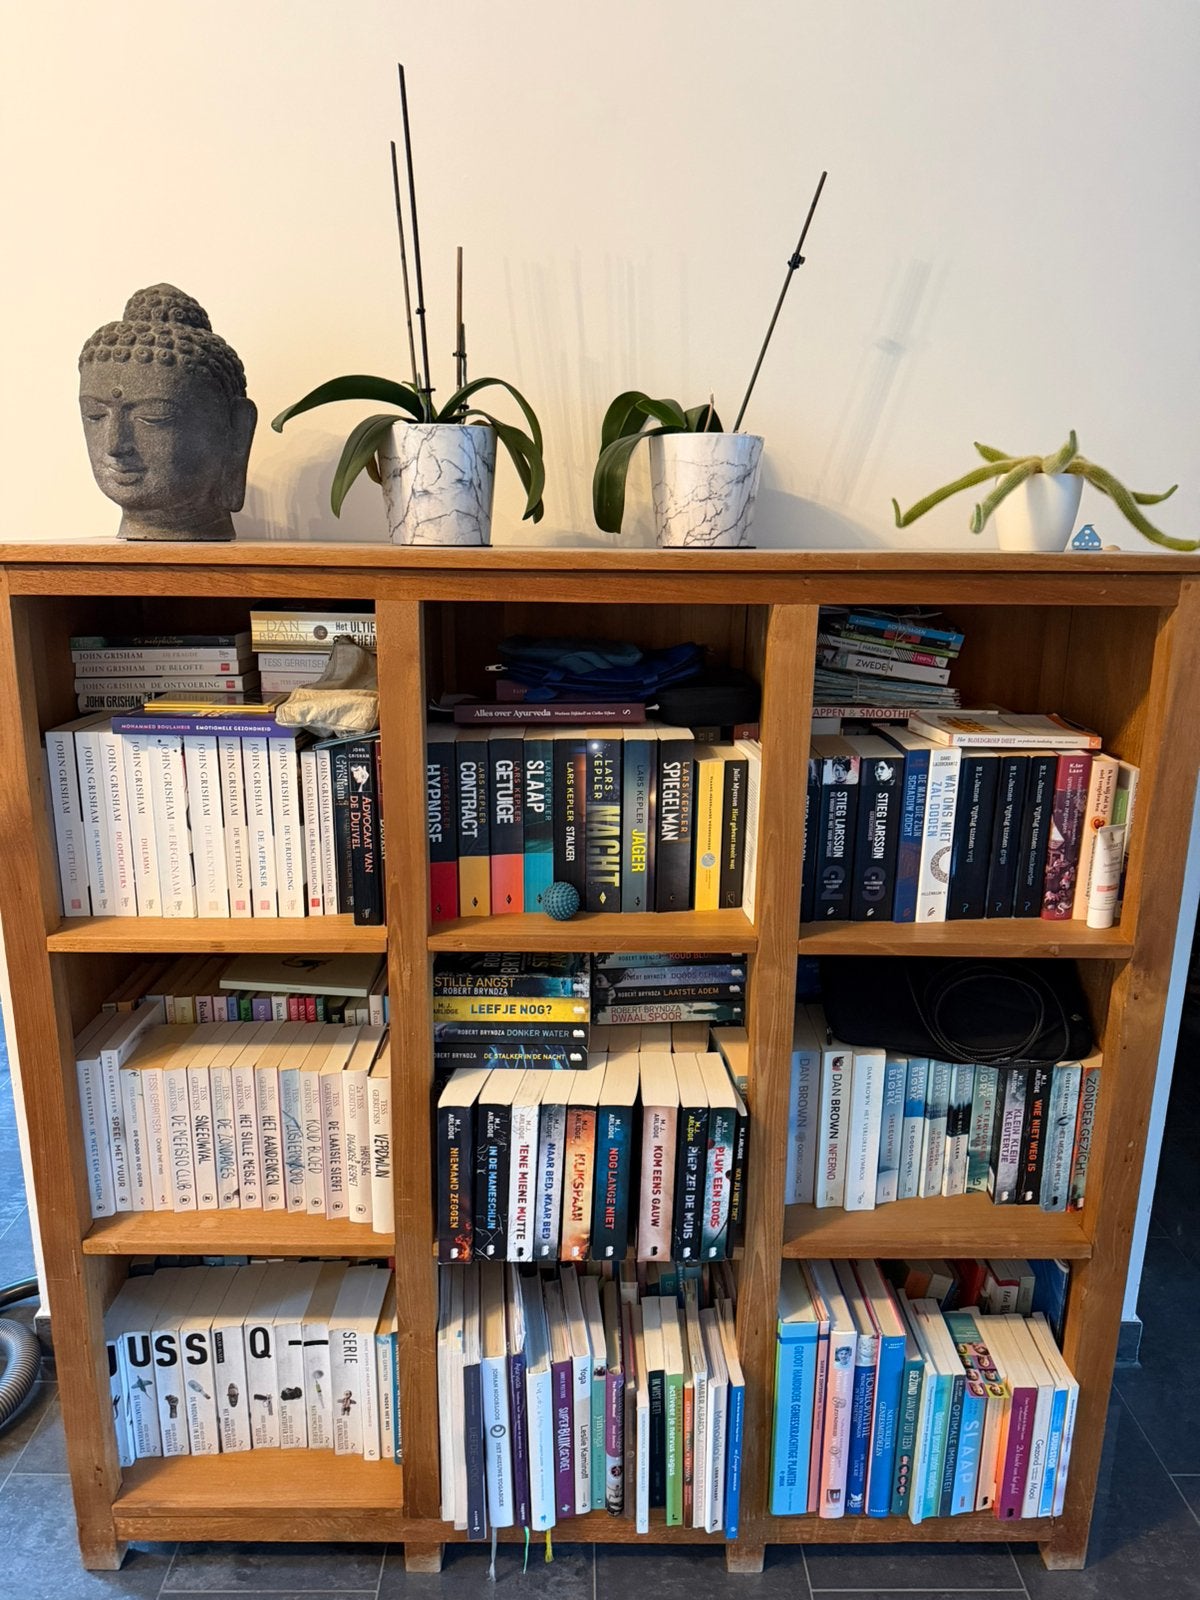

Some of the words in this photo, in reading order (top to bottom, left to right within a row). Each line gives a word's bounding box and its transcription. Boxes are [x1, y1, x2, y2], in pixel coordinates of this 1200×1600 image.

[259, 633, 308, 641] BROWN
[267, 621, 299, 632] DAN
[336, 622, 347, 630] Het
[351, 622, 376, 632] ULTIE
[863, 645, 892, 654] HAMBURG
[855, 659, 893, 672] ZWEDEN
[82, 682, 105, 690] JOHN
[85, 696, 105, 707] JOHN
[107, 695, 142, 707] GRISHAM
[513, 709, 550, 718] Ayurveda
[131, 741, 142, 768] JOHN
[226, 743, 236, 769] JOHN
[251, 743, 261, 769] JOHN
[278, 744, 289, 769] JOHN
[527, 760, 544, 812] SLAAP
[594, 752, 603, 799] KEPLER
[604, 760, 613, 790] LARS
[681, 762, 690, 789] LARS
[918, 774, 927, 784] DE
[945, 775, 956, 793] WAT
[134, 771, 146, 814] GRISHAM
[228, 772, 239, 816] GRISHAM
[253, 772, 264, 816] GRISHAM
[281, 772, 291, 816] GRISHAM
[351, 796, 357, 808] DE
[461, 762, 477, 837] CONTRACT
[497, 760, 513, 824] GETUIGE
[662, 762, 680, 841] SPIEGELMAN
[836, 792, 847, 815] STIEG
[906, 775, 916, 811] SCHADUW
[916, 787, 925, 804] MAN
[932, 782, 942, 801] ZAL
[636, 790, 644, 824] KEPLER
[681, 793, 689, 832] KEPLER
[877, 793, 888, 817] STIEG
[915, 806, 924, 818] DIE
[942, 797, 952, 816] ONS
[233, 828, 241, 837] DE
[284, 825, 291, 836] DE
[352, 812, 360, 849] DUIVEL
[362, 796, 372, 848] ADVOCAAT
[904, 814, 914, 836] ZOCHT
[914, 820, 922, 836] ZIJN
[928, 804, 940, 836] DODEN
[940, 822, 951, 842] NIET
[257, 830, 265, 842] DE
[566, 826, 575, 861] STALKER
[587, 805, 620, 887] NACHT
[834, 818, 845, 857] LARSSON
[873, 820, 886, 858] LARSSON
[141, 838, 150, 874] DILEMMA
[365, 853, 373, 873] VAN
[631, 829, 646, 872] JAGER
[234, 840, 244, 888] WETTELOZEN
[259, 845, 268, 887] AFPERSER
[285, 837, 295, 890] VERDEDIGING
[434, 978, 474, 987] STILLE
[476, 977, 515, 988] ANGST
[472, 987, 508, 995] BRYNDZA
[470, 1005, 502, 1014] LEEF
[502, 1005, 517, 1014] JE
[520, 1004, 552, 1014] NOG?
[507, 1030, 539, 1038] DONKER
[542, 1030, 569, 1038] WATER
[108, 1075, 117, 1113] GERRITSEN
[832, 1074, 842, 1097] DAN
[886, 1069, 895, 1105] BJØRK
[894, 1068, 903, 1104] SAMUEL
[1033, 1099, 1042, 1117] WIE
[1083, 1078, 1096, 1126] ZONDER
[112, 1116, 120, 1142] SPEEL
[171, 1115, 186, 1127] DE
[240, 1114, 252, 1128] HET
[262, 1116, 276, 1132] HET
[306, 1120, 319, 1142] KOUD
[830, 1099, 841, 1139] BROWN
[1031, 1120, 1041, 1139] NIET
[173, 1130, 189, 1167] MEFISTO
[196, 1115, 210, 1164] SNEEUWVAL
[242, 1132, 254, 1156] STILLE
[489, 1146, 498, 1155] IN
[1029, 1142, 1039, 1160] WEG
[114, 1145, 122, 1161] MET
[264, 1136, 278, 1185] AANDENKEN
[308, 1146, 322, 1174] BLOED
[488, 1157, 497, 1170] DE
[608, 1148, 618, 1168] NOG
[652, 1146, 663, 1168] KOM
[713, 1146, 725, 1174] PLUK
[827, 1143, 837, 1180] INFERNO
[1076, 1128, 1091, 1177] GEZICHT
[116, 1164, 125, 1188] VUUR
[176, 1169, 191, 1191] CLUB
[243, 1158, 256, 1185] MEISJE
[1028, 1163, 1037, 1172] IS
[571, 1154, 586, 1221] KLIKSPAAN
[607, 1171, 617, 1204] LANGE
[652, 1170, 662, 1195] EENS
[712, 1177, 723, 1198] EEN
[488, 1172, 498, 1229] MANESCHIJN
[651, 1198, 661, 1227] GAUW
[605, 1206, 615, 1229] NIET
[710, 1201, 720, 1227] ROOS
[343, 1333, 358, 1364] SERIE
[794, 1346, 804, 1367] GROOT
[579, 1367, 588, 1384] Yoga
[792, 1369, 802, 1402] HANDBOEK
[908, 1370, 919, 1395] GEZOND
[668, 1385, 676, 1417] activeer
[907, 1396, 918, 1408] VAN
[905, 1422, 915, 1433] TOT
[906, 1410, 915, 1420] KOP
[949, 1404, 961, 1444] OPTIMALE
[593, 1415, 604, 1447] yinyoga
[789, 1404, 801, 1458] GENEESKRACHTIGE
[902, 1435, 913, 1449] TEEN
[960, 1421, 979, 1484] SLAAP
[1032, 1439, 1044, 1466] Gezond
[787, 1461, 798, 1486] PLANTEN
[944, 1447, 955, 1492] IMMUNITEIT
[1029, 1482, 1038, 1499] Mooi
